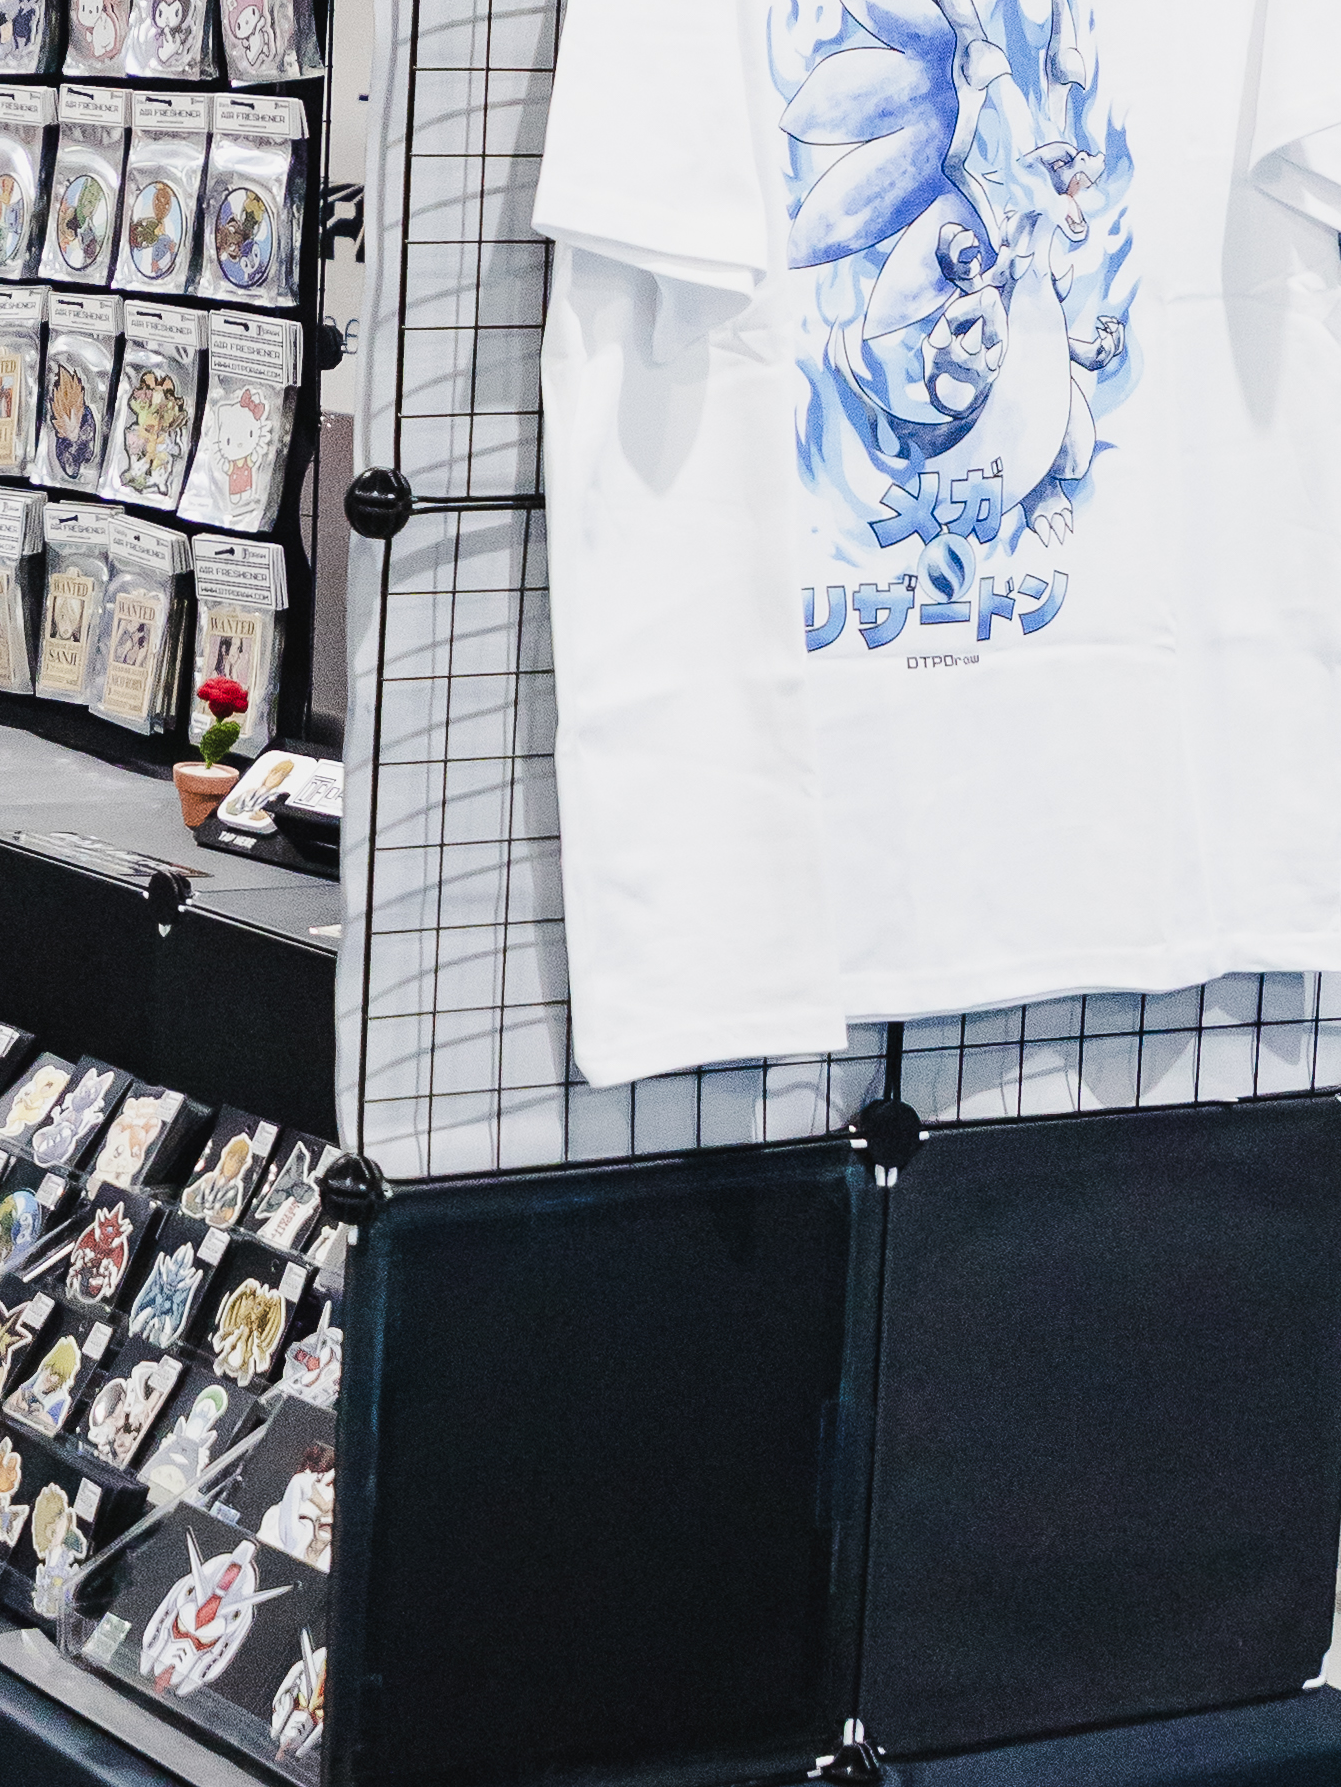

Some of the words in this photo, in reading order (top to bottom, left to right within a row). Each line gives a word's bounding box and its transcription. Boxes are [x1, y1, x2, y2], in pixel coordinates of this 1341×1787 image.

[213, 341, 228, 351] AIR
[230, 343, 280, 359] FRESHENER
[868, 456, 1004, 549] メガ
[198, 567, 214, 576] AIR
[216, 568, 267, 582] FRESHENER
[118, 600, 156, 621] WANTED
[210, 617, 256, 636] WANTED
